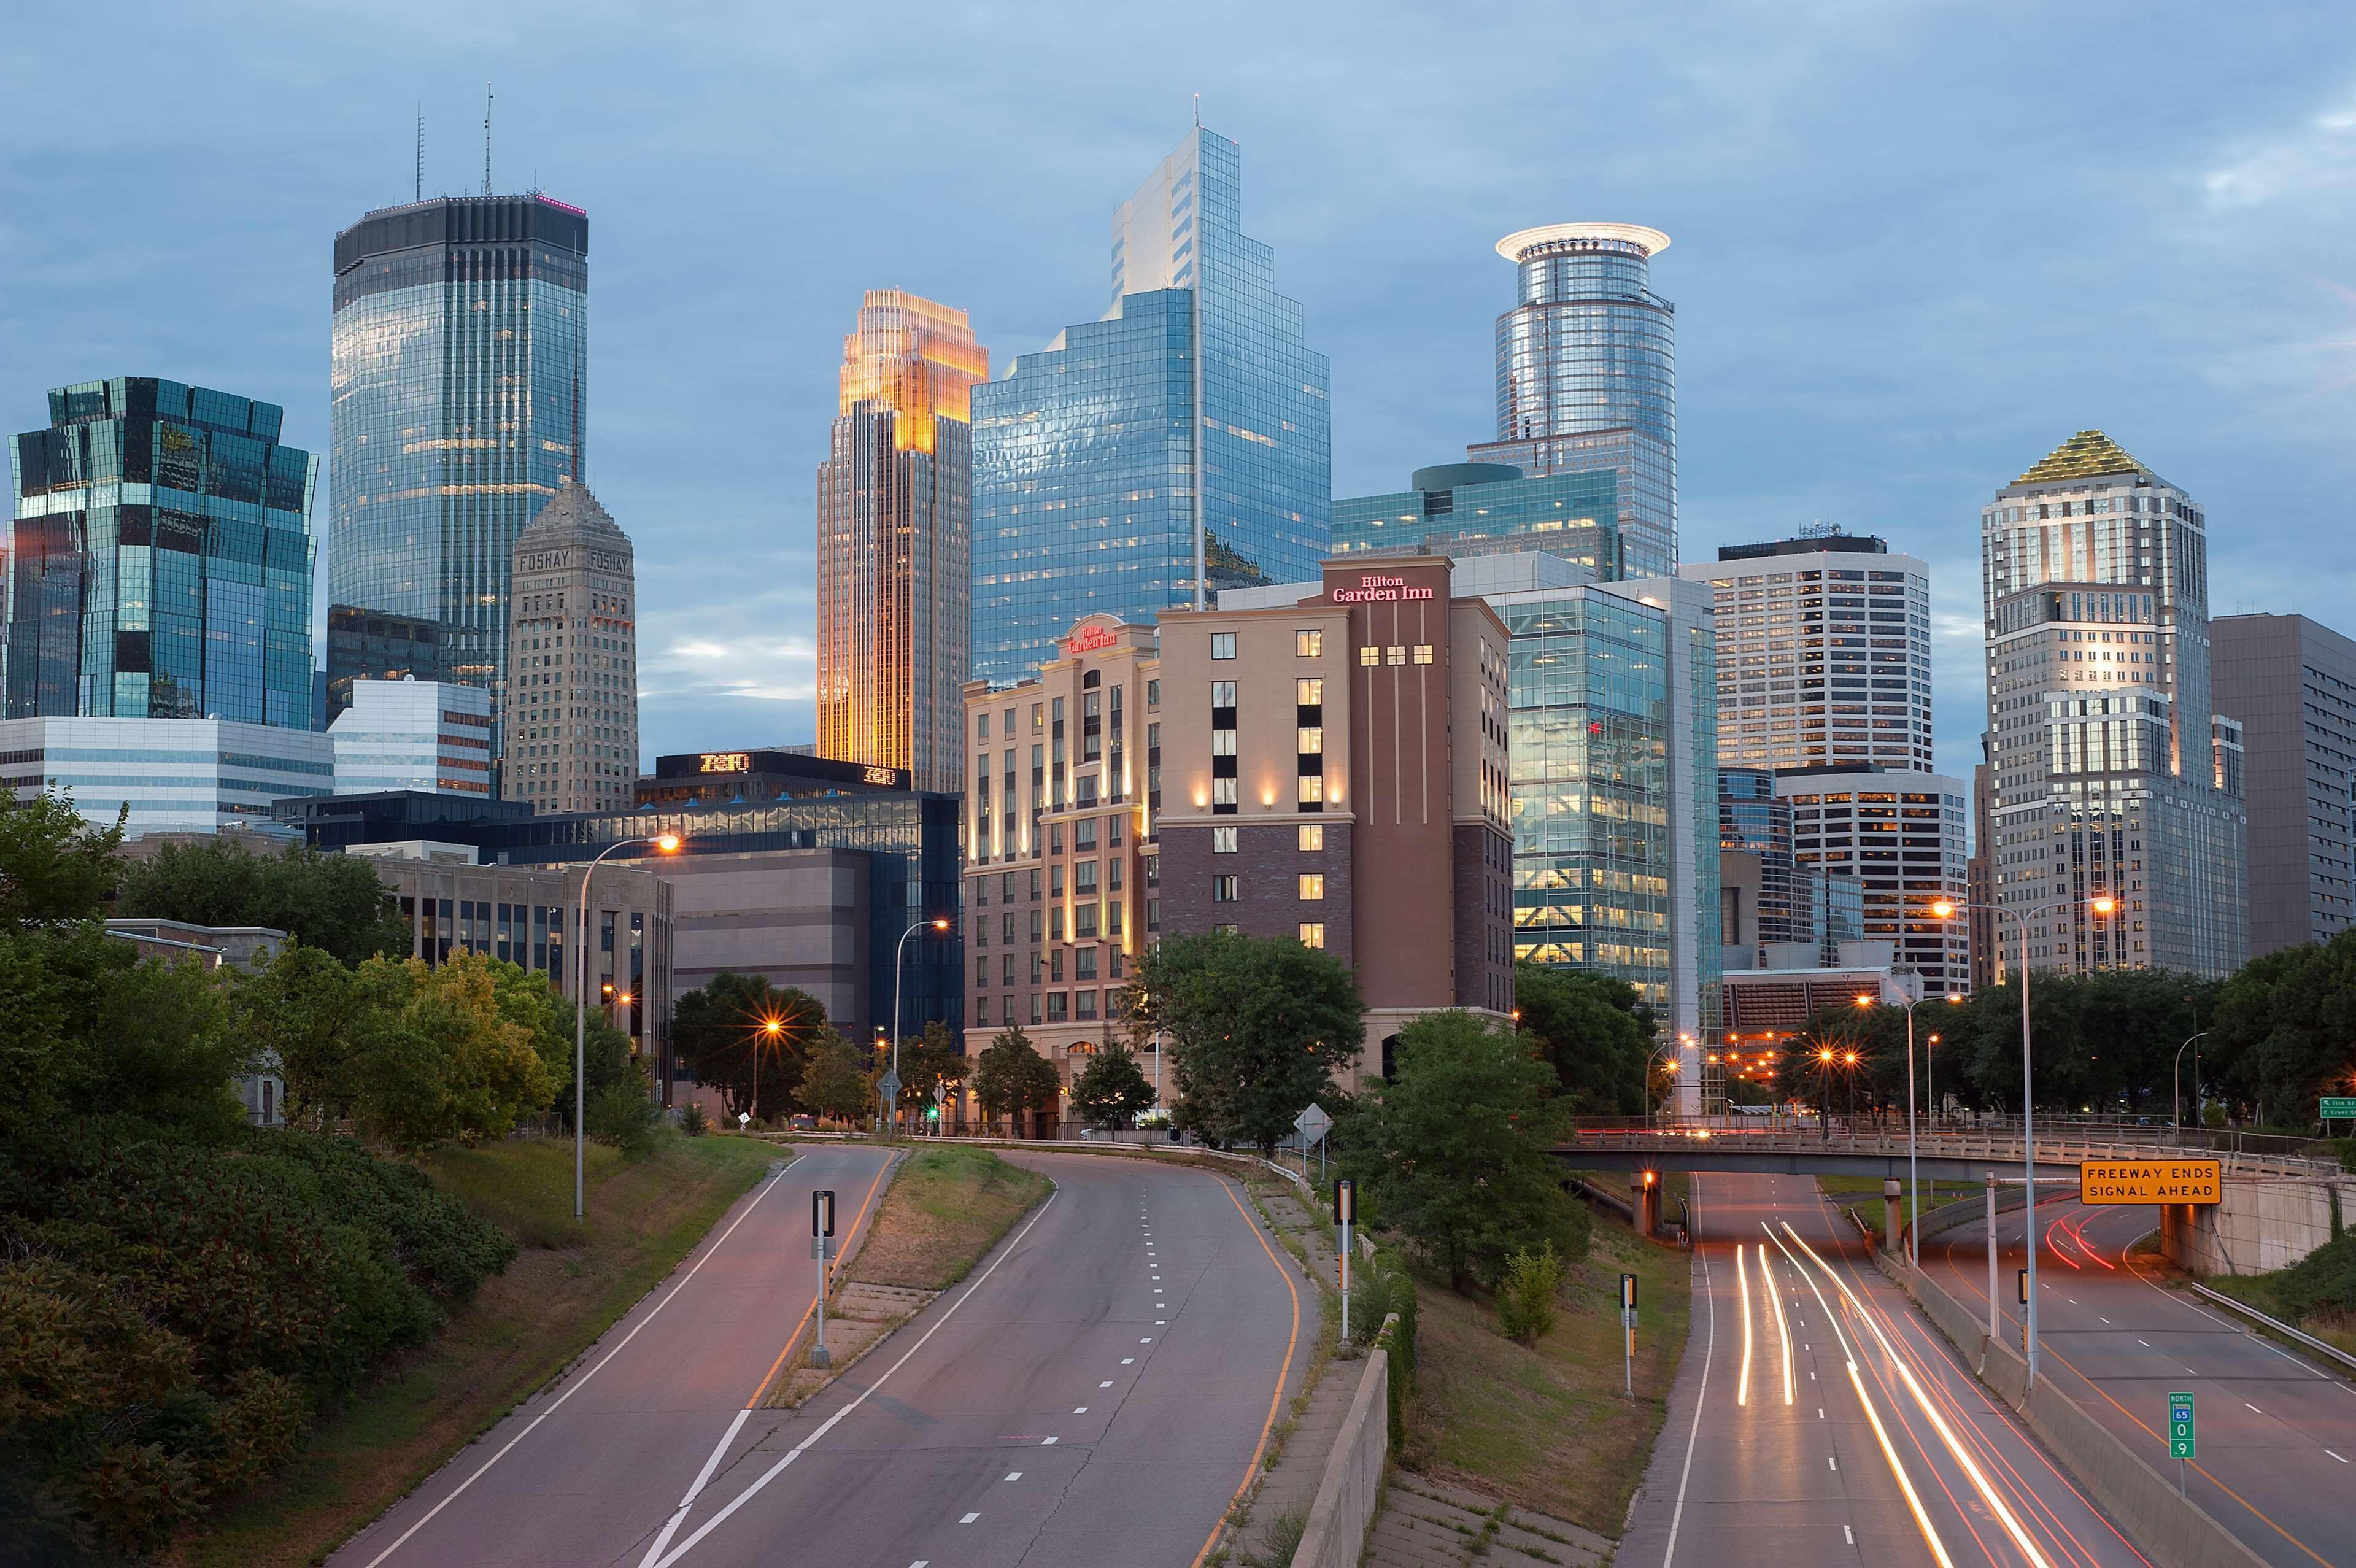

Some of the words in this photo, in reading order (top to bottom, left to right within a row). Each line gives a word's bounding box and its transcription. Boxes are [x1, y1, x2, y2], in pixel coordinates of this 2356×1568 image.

[520, 550, 569, 571] FOSHAY
[590, 550, 628, 573] FOSHAY
[1362, 577, 1404, 587] Hilton
[1333, 587, 1398, 602] Garden
[1402, 586, 1434, 600] Inn
[1082, 627, 1103, 638] Hilton
[1068, 638, 1100, 652] Garden
[1100, 634, 1116, 646] Inn
[2088, 1168, 2163, 1179] FREEWAY
[2172, 1168, 2214, 1179] ENDS
[2090, 1186, 2148, 1197] SIGNAL
[2157, 1186, 2212, 1196] AHEAD
